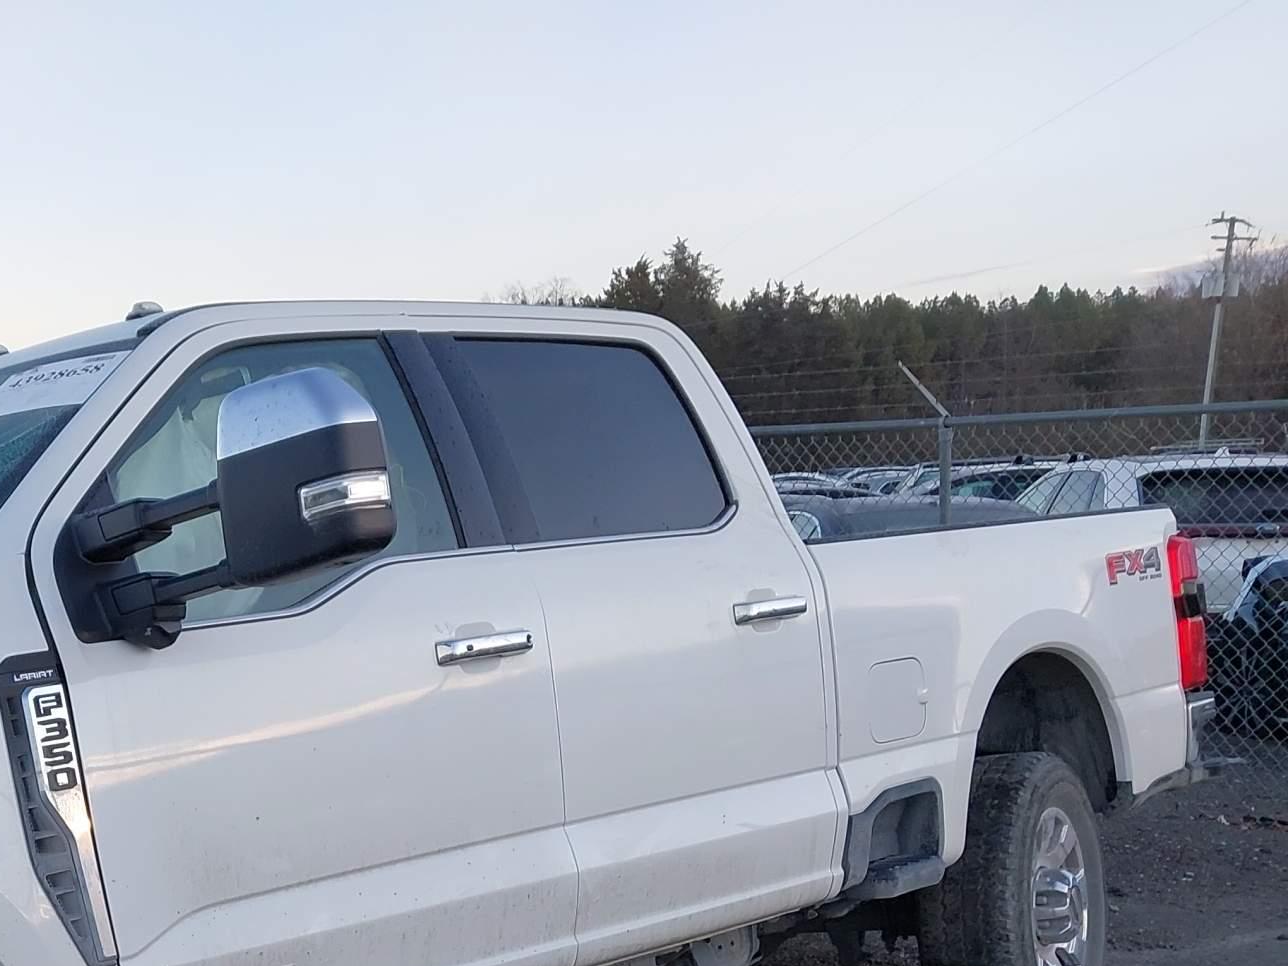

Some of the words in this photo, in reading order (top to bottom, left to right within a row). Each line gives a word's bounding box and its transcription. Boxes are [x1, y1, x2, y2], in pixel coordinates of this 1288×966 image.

[1105, 546, 1162, 586] FX4
[13, 668, 54, 682] LARIAT
[32, 691, 78, 792] F350
